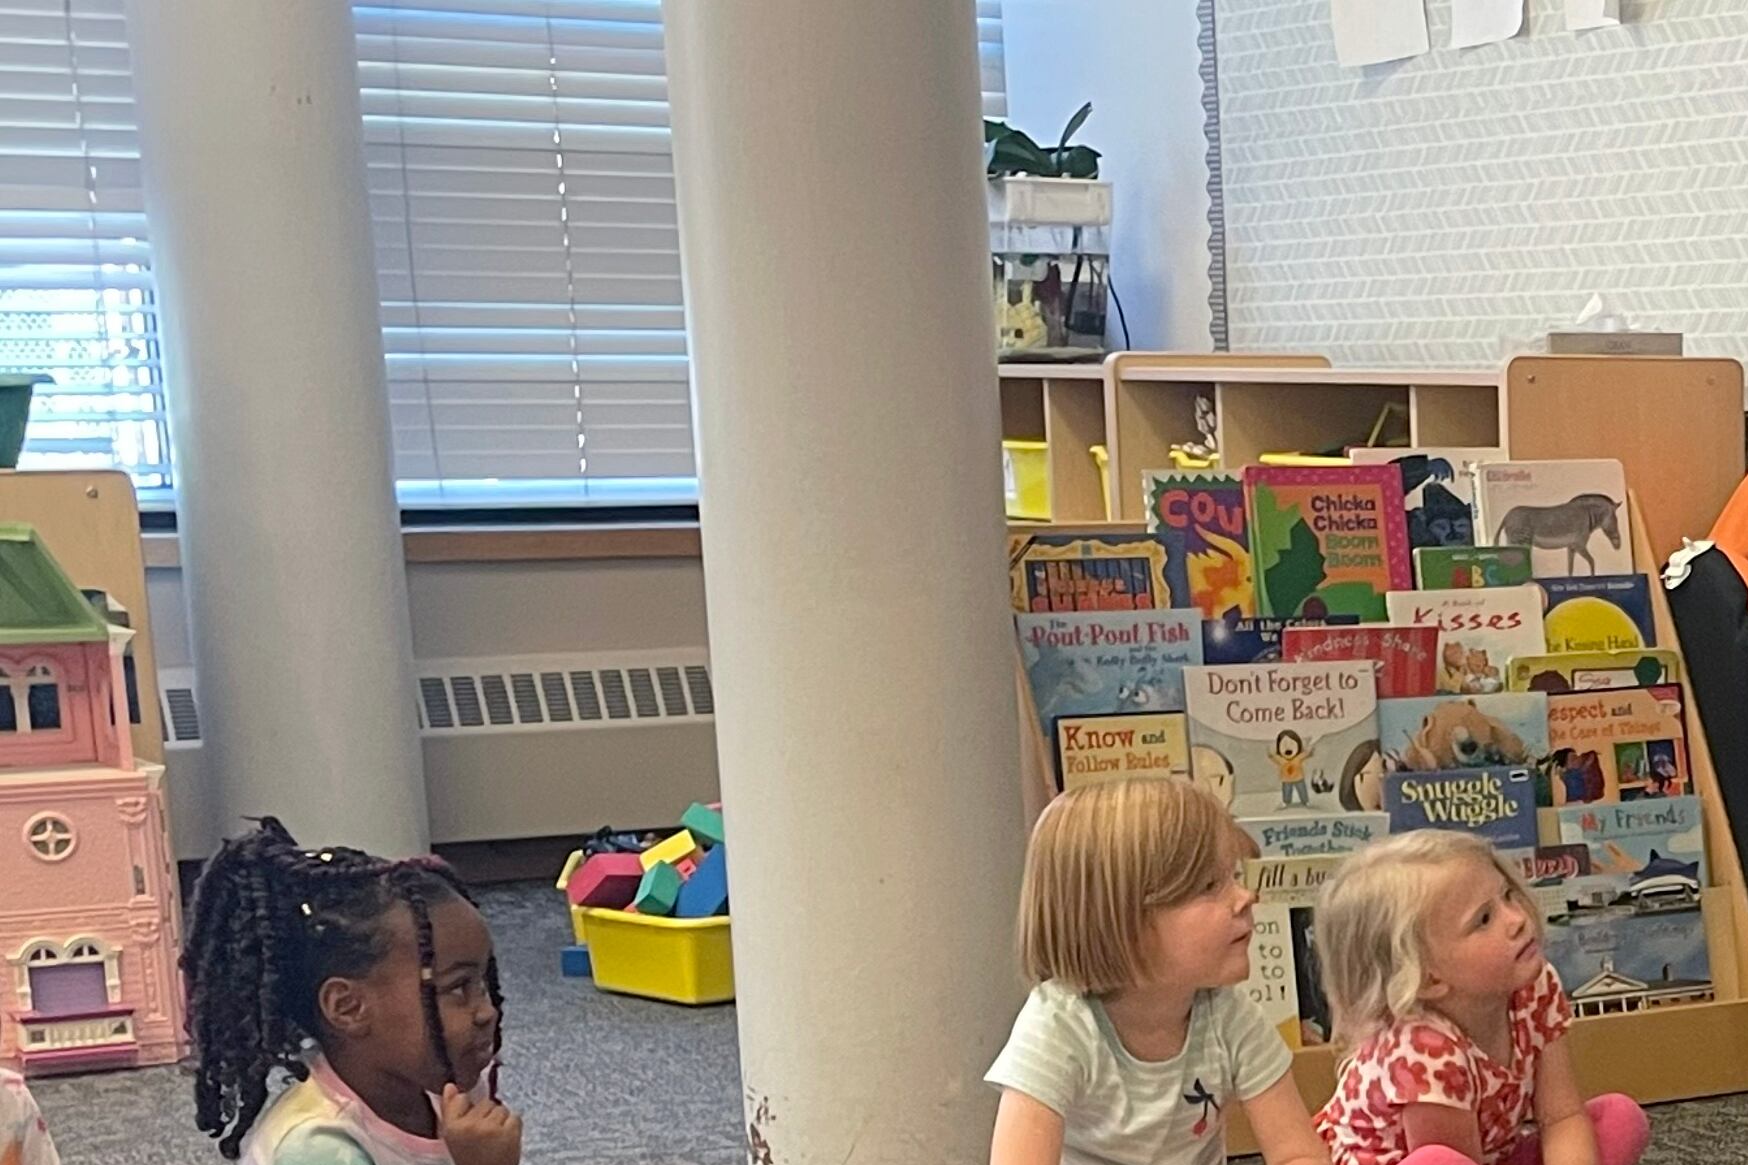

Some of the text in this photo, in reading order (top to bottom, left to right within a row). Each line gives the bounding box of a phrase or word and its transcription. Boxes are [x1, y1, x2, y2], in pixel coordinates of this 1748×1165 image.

[1311, 494, 1376, 513] Chicka
[1313, 515, 1378, 532] Chicka
[1326, 533, 1379, 550] Boom
[1327, 551, 1381, 568] Boom
[1453, 564, 1500, 587] ABC
[1149, 620, 1190, 642] Fish
[1235, 621, 1254, 632] All
[1413, 607, 1522, 632] Kisses
[1208, 669, 1358, 695] Don't Forget to
[1226, 698, 1344, 723] Come Back!
[1548, 699, 1607, 722] espect
[1063, 725, 1166, 751] Know and
[1067, 751, 1170, 774] Follow Rules
[1401, 773, 1502, 804] Snuggle
[1424, 797, 1519, 827] Wuggle
[1262, 820, 1374, 847] Friends Stick
[1255, 864, 1285, 894] fill
[1259, 943, 1283, 959] to
[1261, 965, 1285, 980] to
